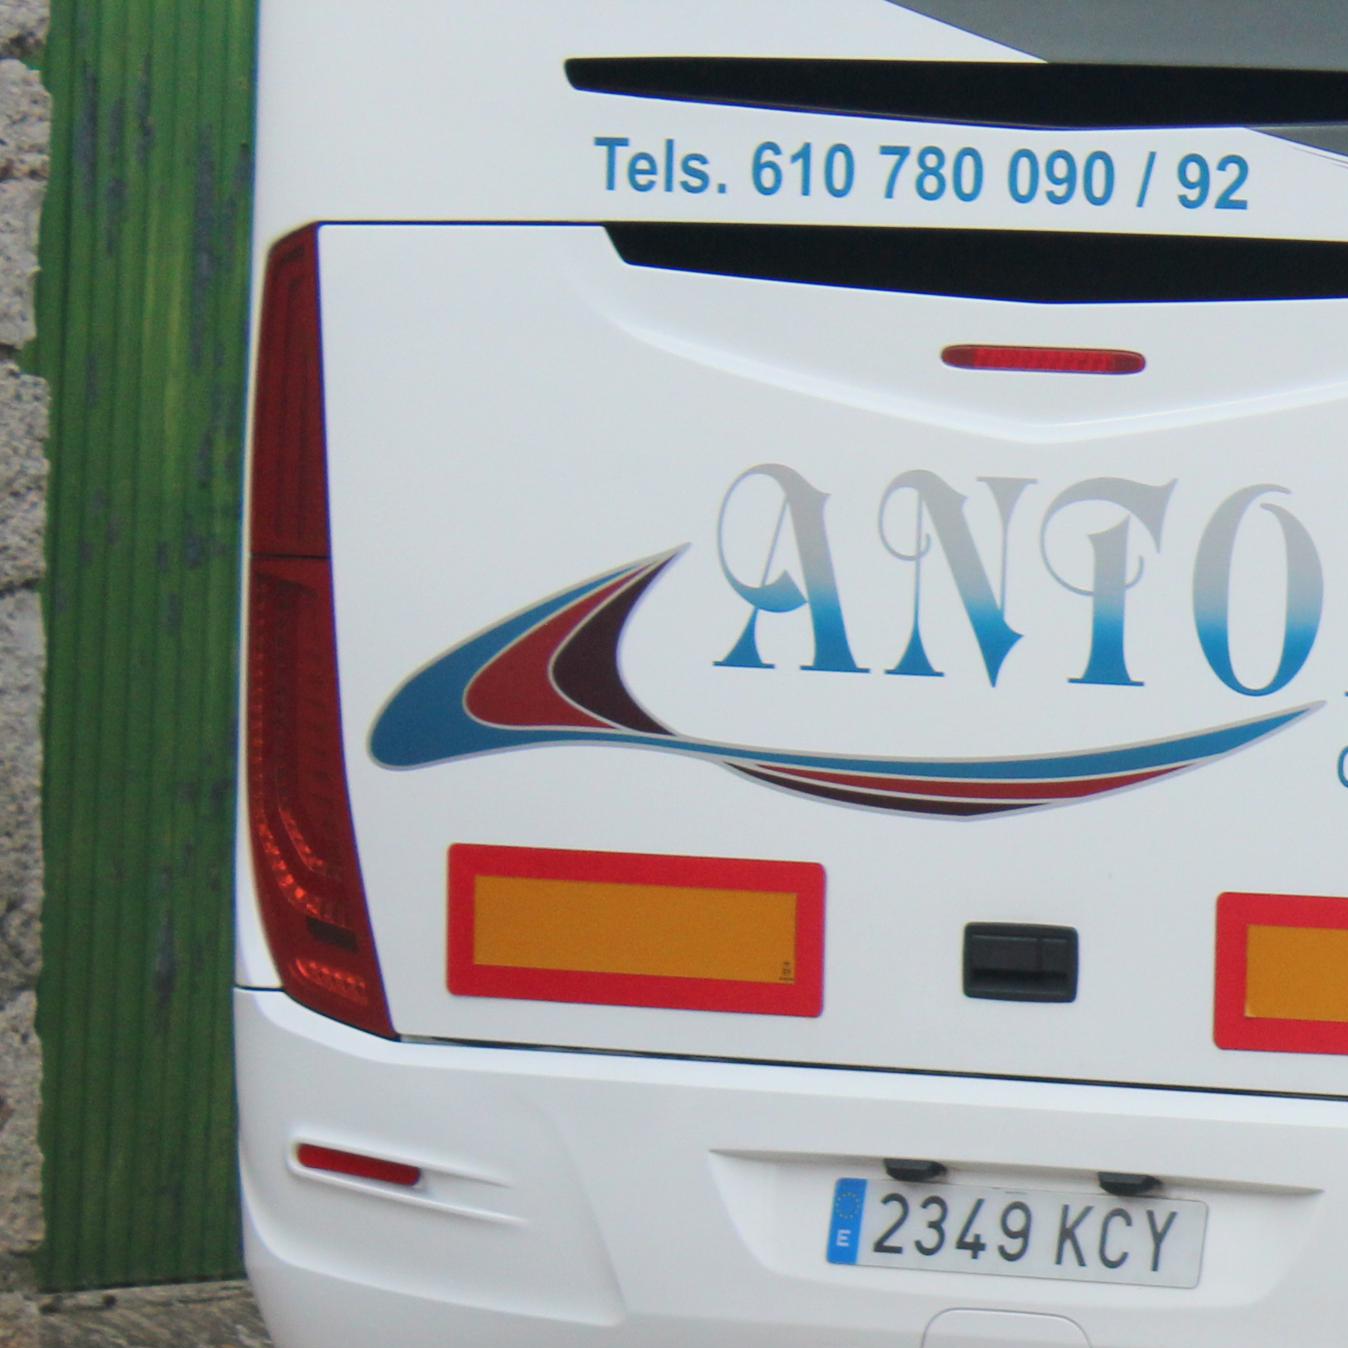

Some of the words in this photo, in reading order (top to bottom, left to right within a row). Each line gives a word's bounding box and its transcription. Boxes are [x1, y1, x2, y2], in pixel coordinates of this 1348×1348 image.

[594, 137, 728, 195] Tels.
[752, 142, 856, 198] 610
[879, 146, 985, 203] 780
[1008, 149, 1116, 206] 090
[1137, 151, 1157, 208] /
[1177, 154, 1249, 211] 92
[836, 1229, 851, 1247] E
[873, 1193, 1032, 1262] 2349
[1055, 1204, 1177, 1272] KCY
